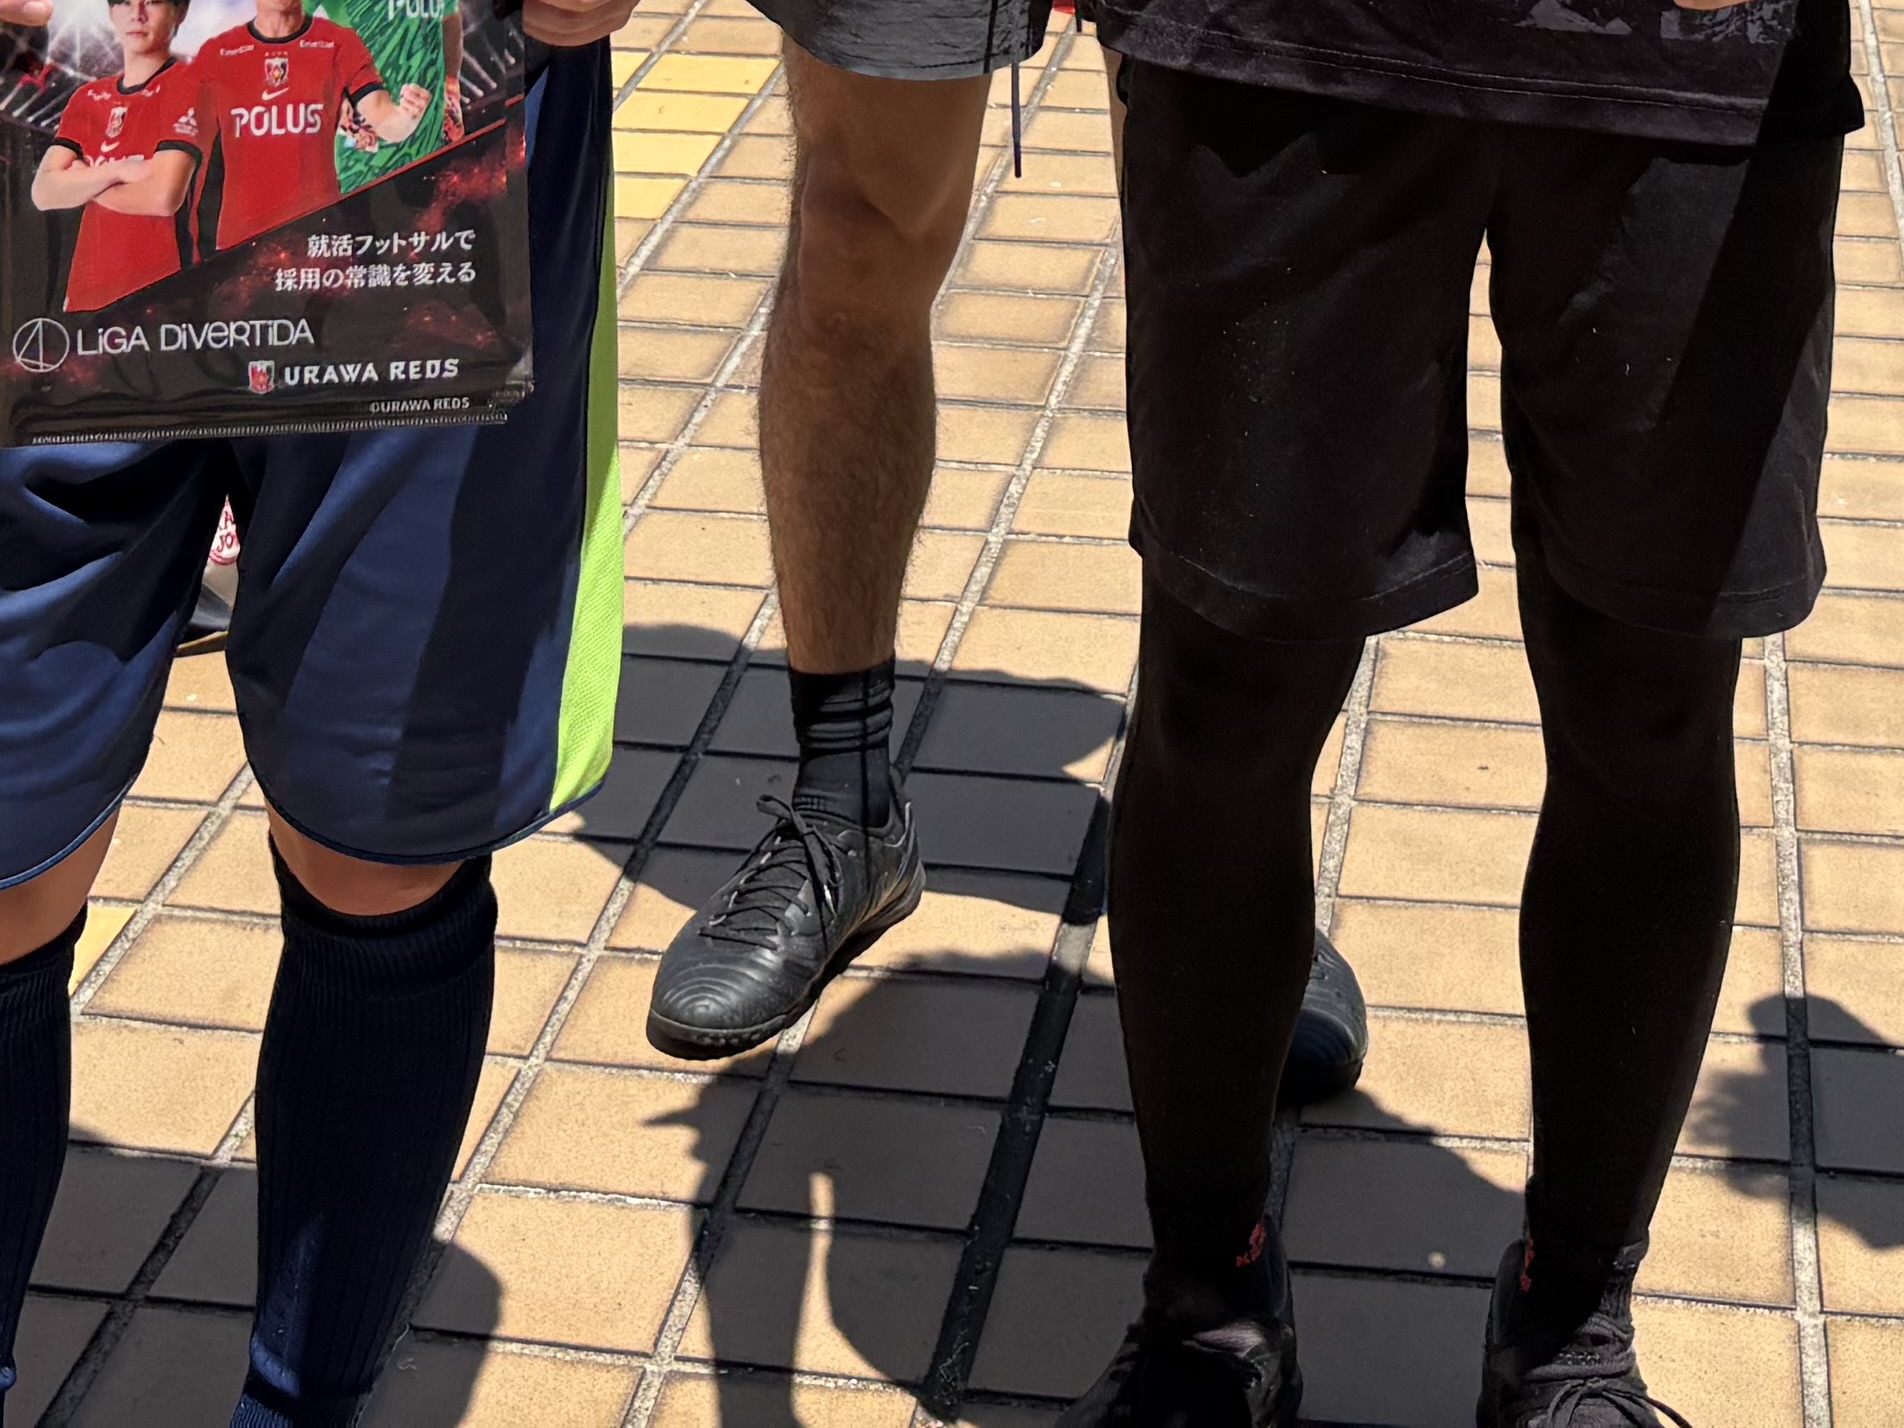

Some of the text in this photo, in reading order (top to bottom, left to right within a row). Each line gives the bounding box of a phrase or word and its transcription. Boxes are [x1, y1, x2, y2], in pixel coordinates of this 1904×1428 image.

[230, 101, 324, 138] POLUS
[306, 228, 477, 258] 就活フットサルで
[274, 261, 477, 293] 採用の常識を変える
[77, 324, 151, 356] LiGA
[284, 358, 460, 386] URAWA REDS
[433, 396, 471, 412] REDS
